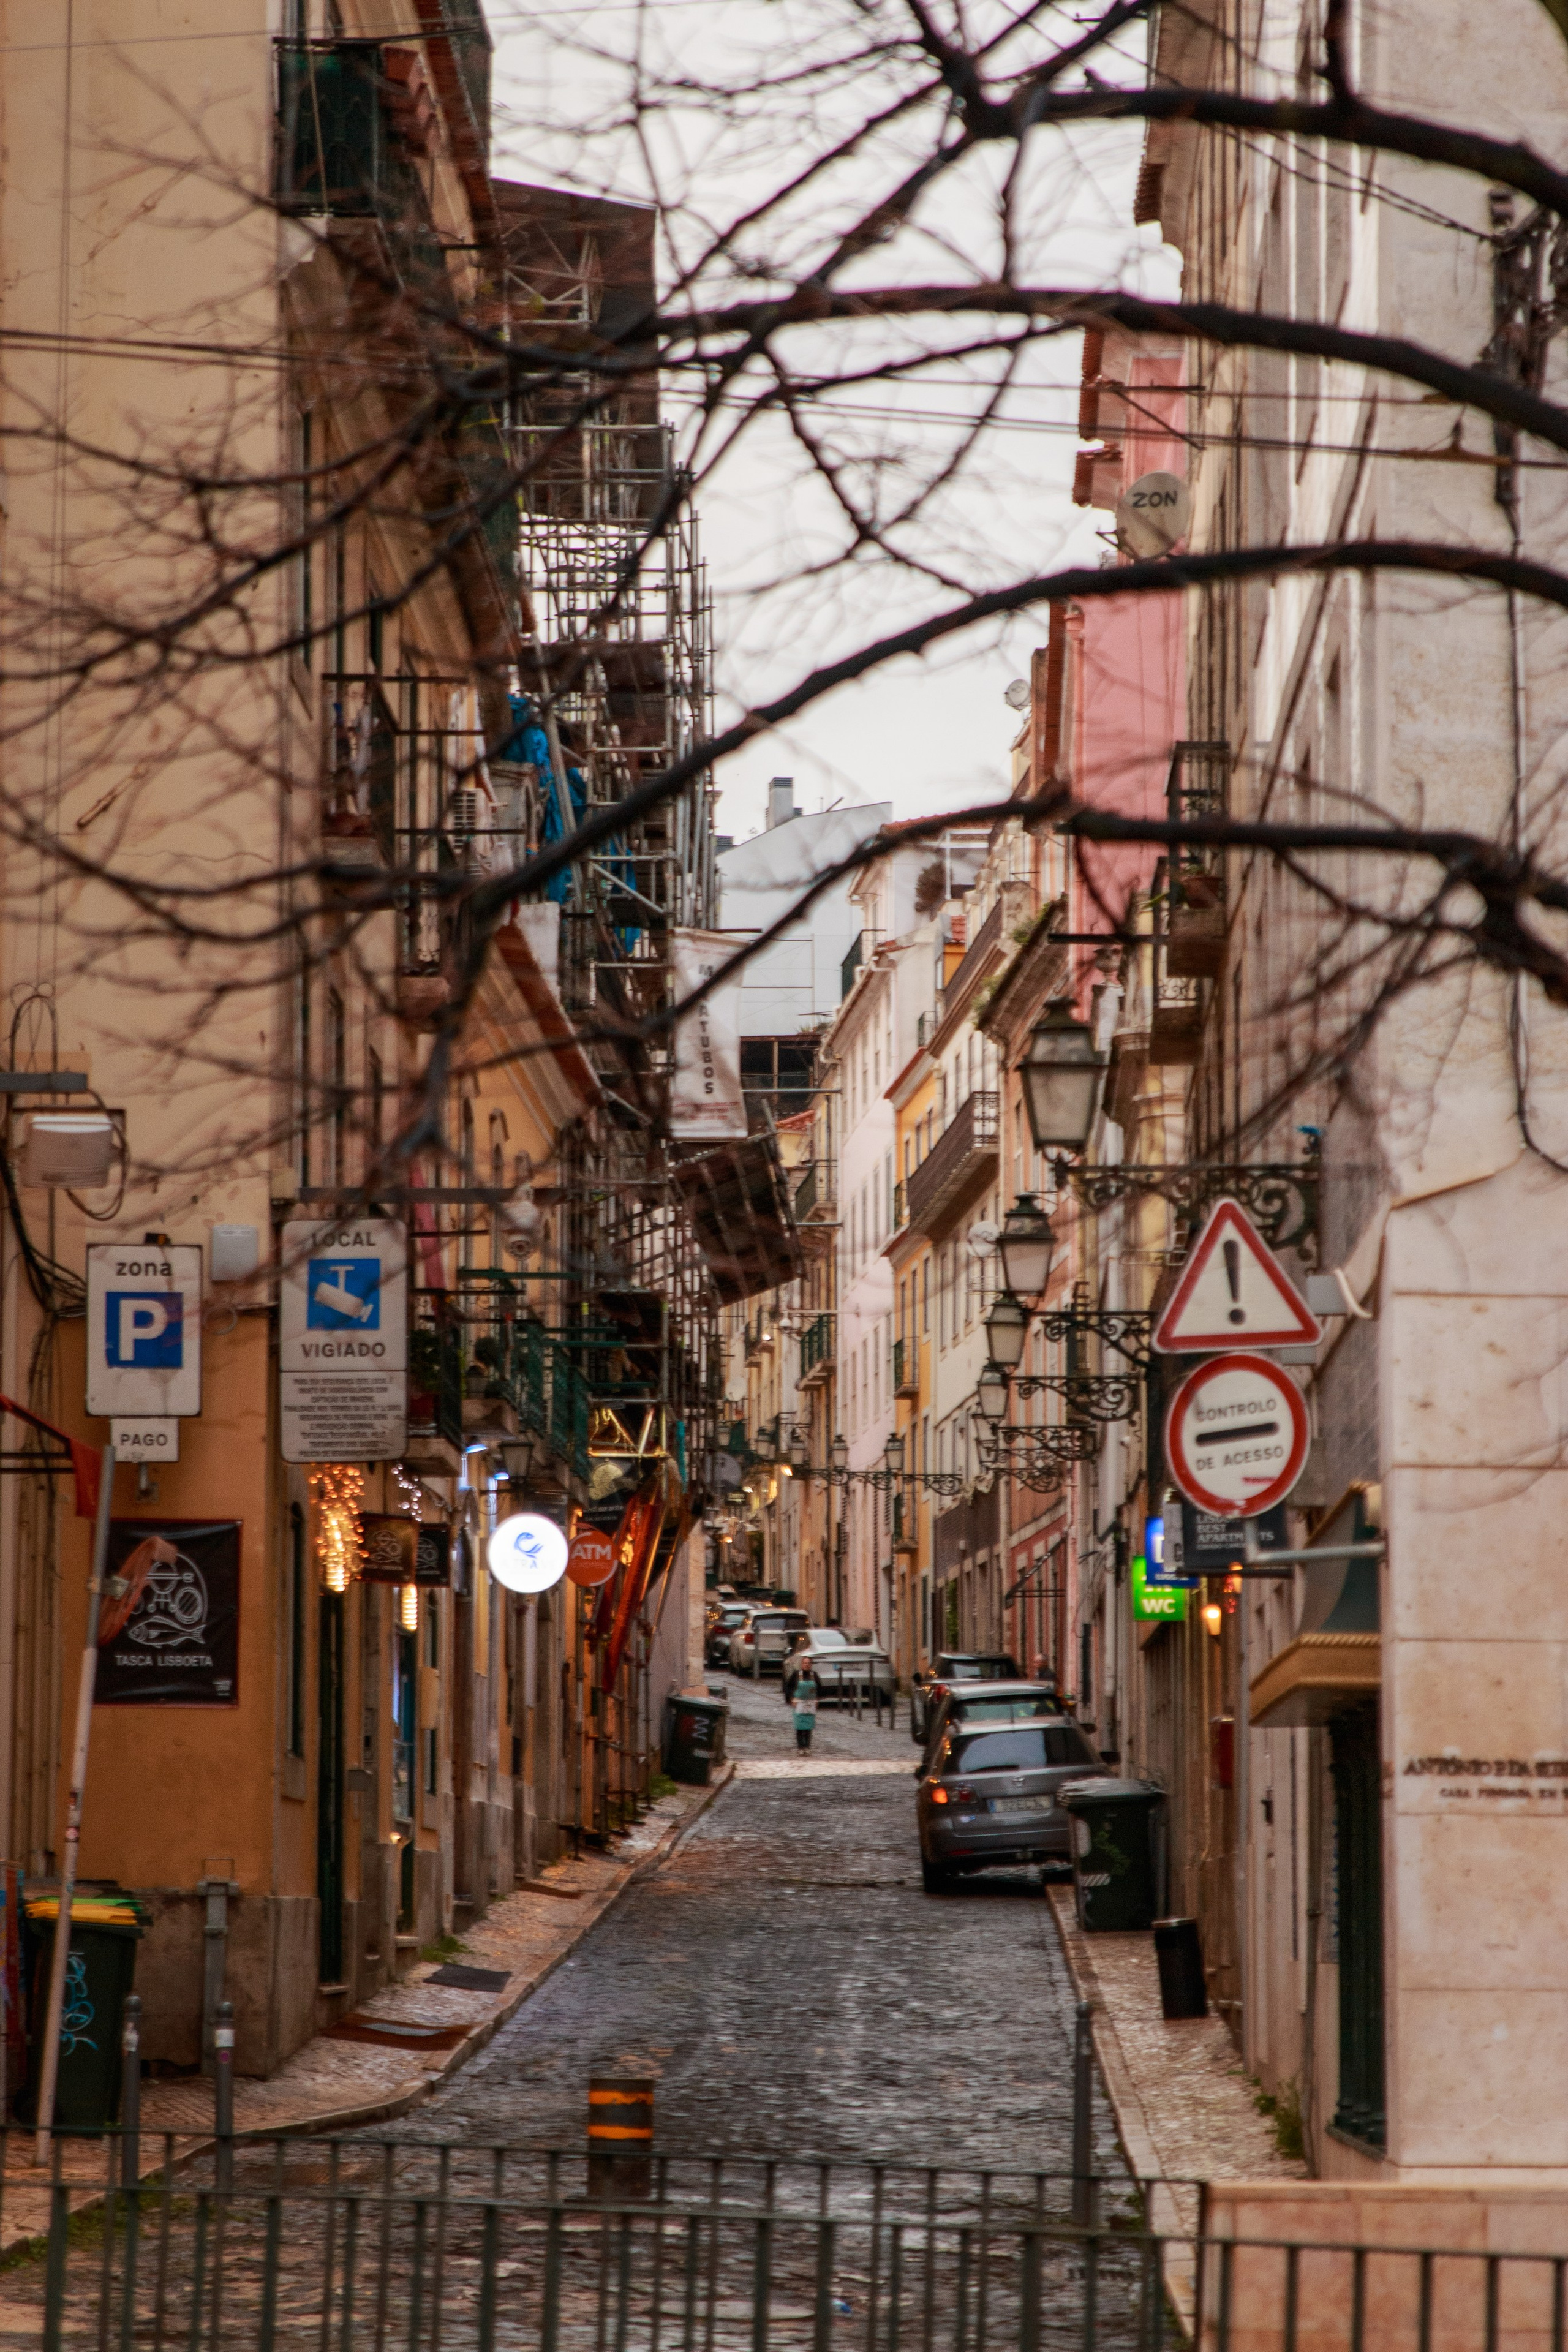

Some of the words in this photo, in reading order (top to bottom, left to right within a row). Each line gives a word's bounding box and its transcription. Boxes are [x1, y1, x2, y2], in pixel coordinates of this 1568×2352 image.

[1132, 491, 1178, 508] ZON
[699, 964, 714, 1095] MATUBOS
[311, 1231, 376, 1247] LOCAL
[116, 1262, 173, 1277] zona
[119, 1300, 168, 1361] P
[301, 1342, 386, 1358] VIGIADO
[1196, 1398, 1276, 1422] CONTROLO
[120, 1434, 168, 1447] PAGO
[1196, 1458, 1215, 1471] DE
[1223, 1446, 1284, 1466] ACESSO
[1196, 1524, 1226, 1533] BEST
[1196, 1531, 1275, 1544] APARTMTS
[571, 1544, 612, 1560] ATM
[1141, 1598, 1176, 1615] WC
[115, 1655, 153, 1666] TASCA
[157, 1655, 213, 1666] LISBOETA
